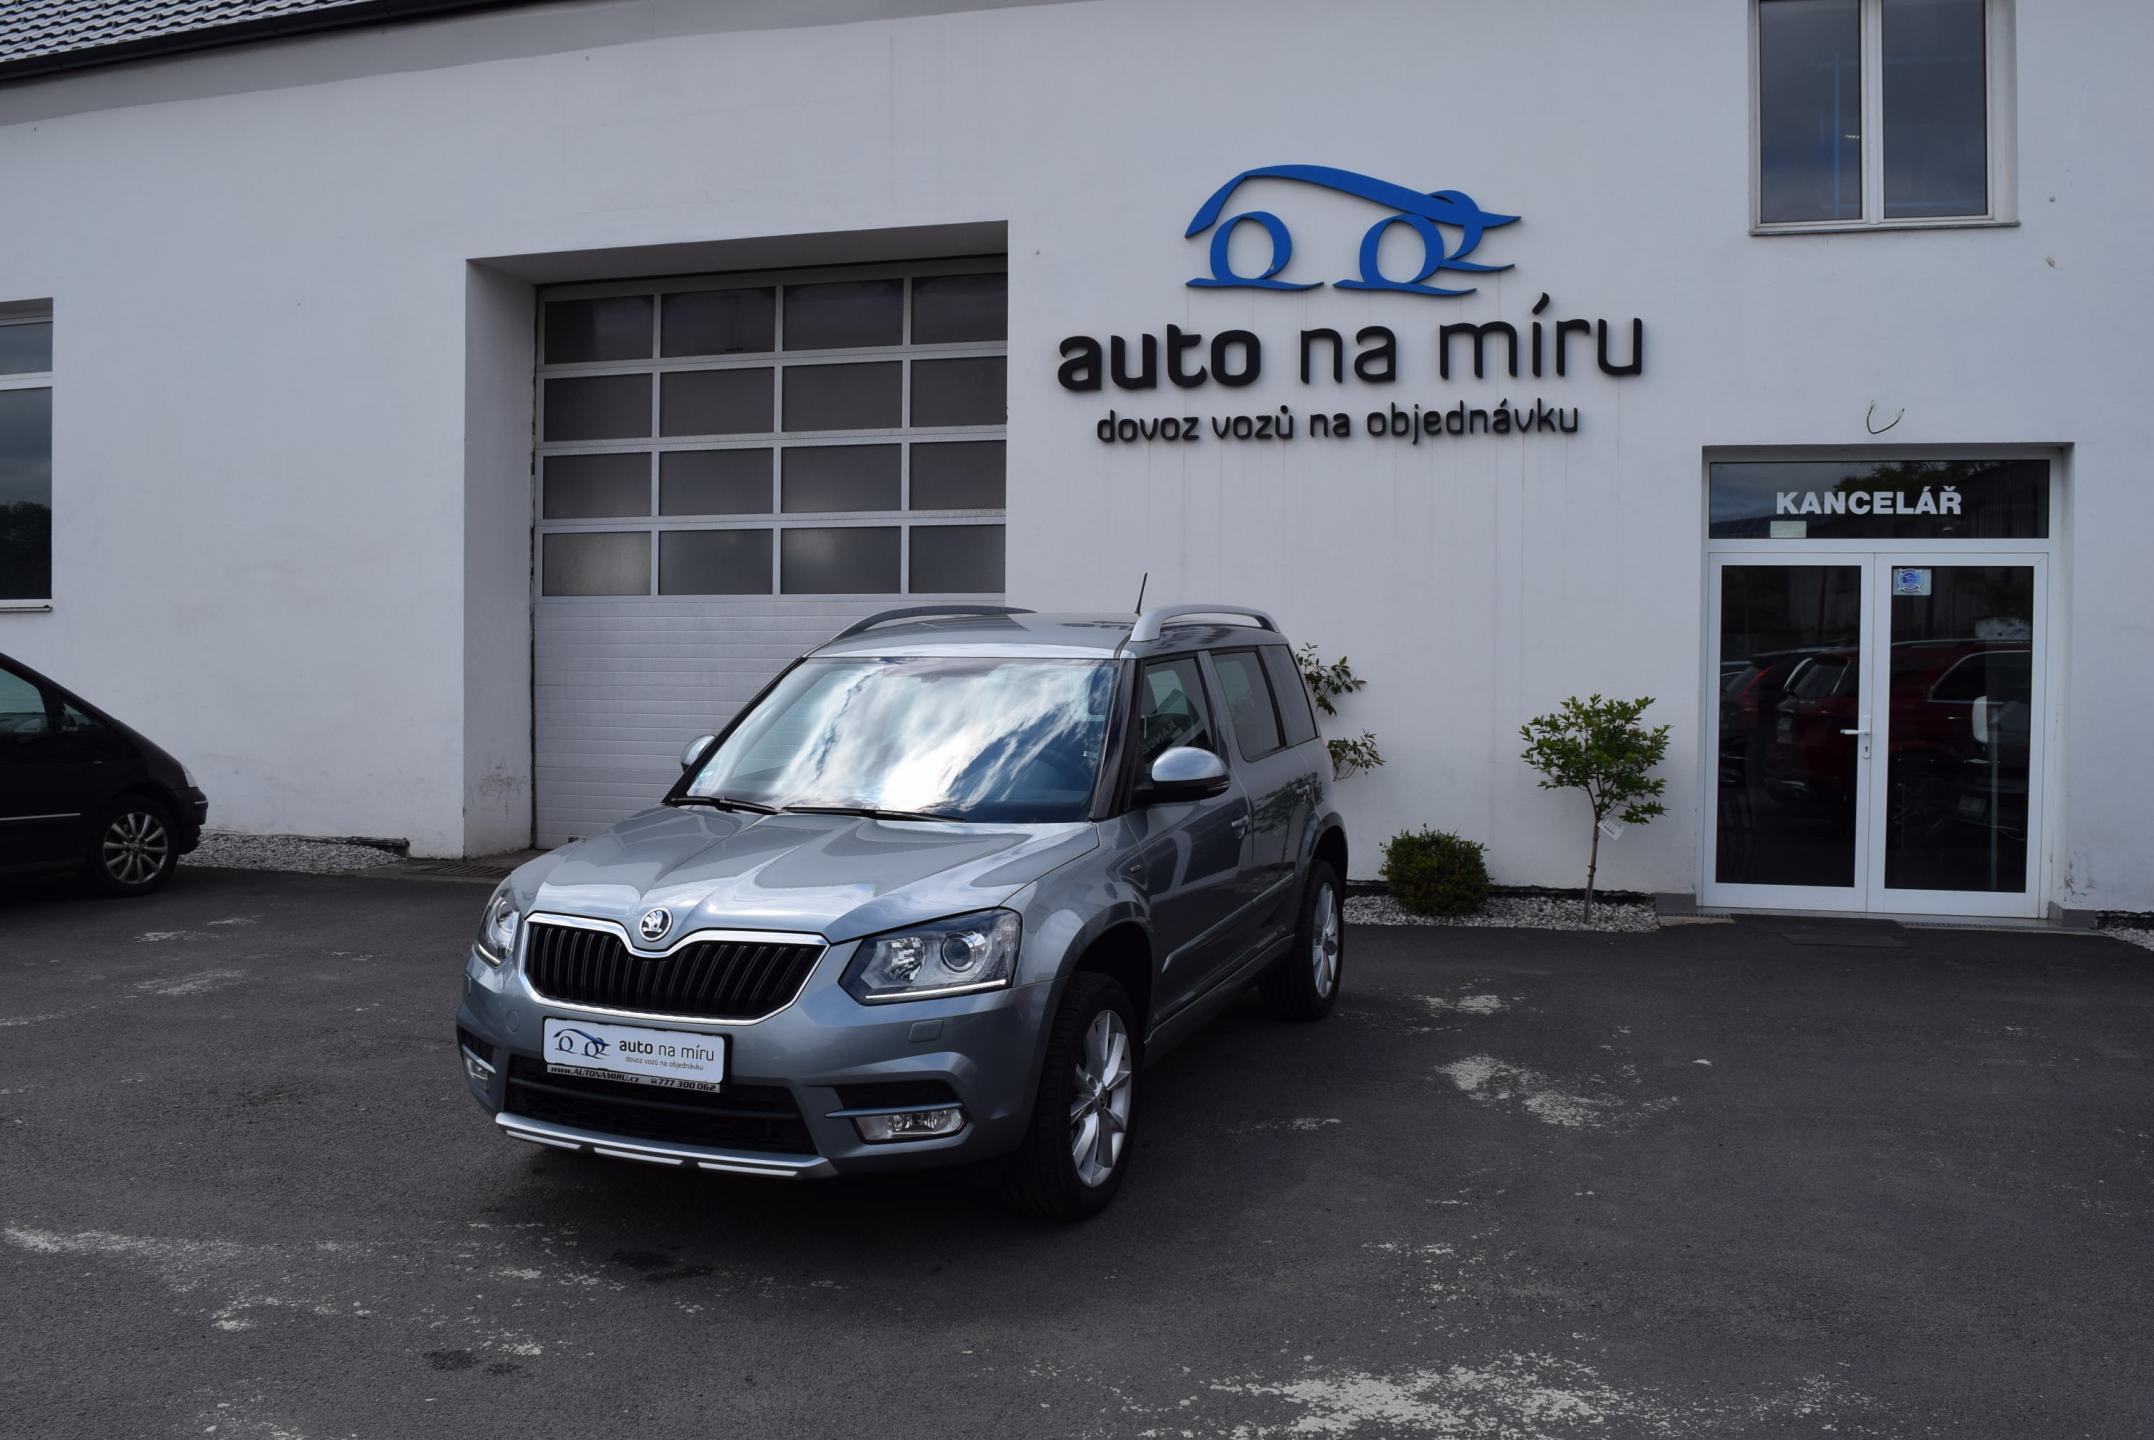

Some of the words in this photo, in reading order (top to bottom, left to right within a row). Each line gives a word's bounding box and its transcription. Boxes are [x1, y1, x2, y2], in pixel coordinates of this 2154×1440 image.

[1057, 323, 1262, 394] auto
[1300, 325, 1397, 386] na
[1439, 292, 1644, 381] míru
[1097, 409, 1200, 444] dovoz
[1211, 404, 1295, 442] vozů
[1309, 412, 1352, 440] na
[1367, 398, 1579, 446] objednávku
[1776, 485, 1962, 515] KANCELÁŘ
[619, 1039, 653, 1055] auto
[659, 1044, 675, 1057] na
[681, 1043, 714, 1062] míru
[625, 1055, 643, 1064] dovoz
[669, 1061, 704, 1071] objednávku
[678, 1081, 695, 1089] 300
